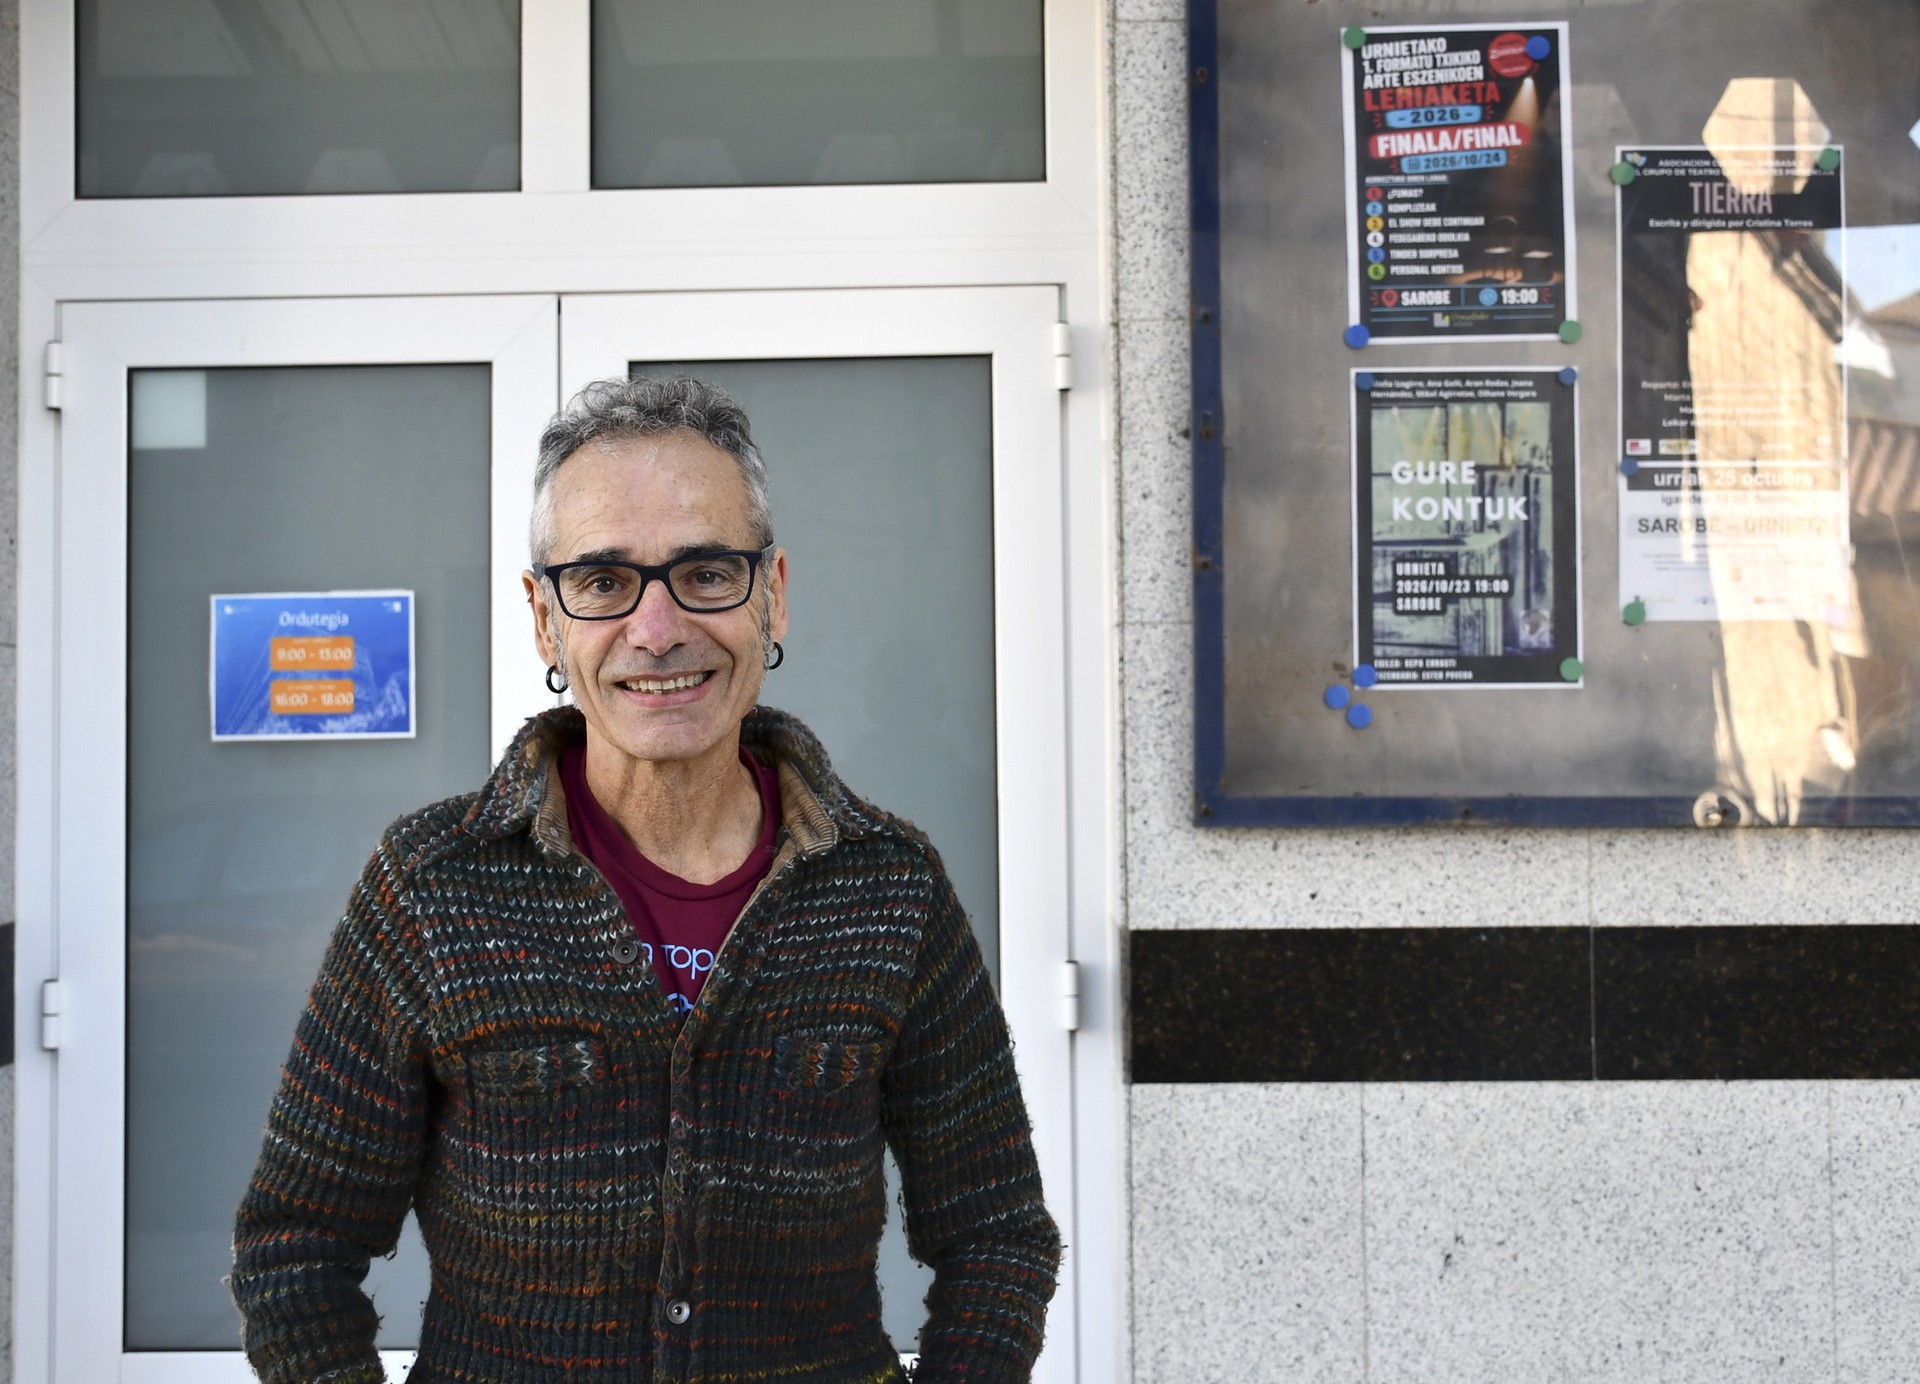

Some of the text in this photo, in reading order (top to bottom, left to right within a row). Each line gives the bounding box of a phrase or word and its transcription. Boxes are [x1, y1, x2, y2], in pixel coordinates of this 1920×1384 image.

[1361, 37, 1447, 59] URNIETAKO
[1376, 55, 1434, 73] FORMATU
[1363, 72, 1400, 89] ARTE
[1403, 66, 1484, 86] ESZENIKOEN
[1363, 82, 1501, 111] LEHIAKETA
[1411, 107, 1460, 123] 2026
[1377, 124, 1522, 157] FINALA/FINAL
[1689, 181, 1773, 214] TIERRA
[1728, 220, 1744, 229] por
[1401, 290, 1452, 306] SAROBE
[1500, 289, 1539, 305] 19:00
[1391, 460, 1476, 485] GURE
[1714, 471, 1737, 486] 25
[1392, 496, 1528, 521] KONTUK
[1396, 562, 1445, 576] URNIETA
[1396, 597, 1442, 611] SAROBE
[279, 611, 350, 631] Ordutegia
